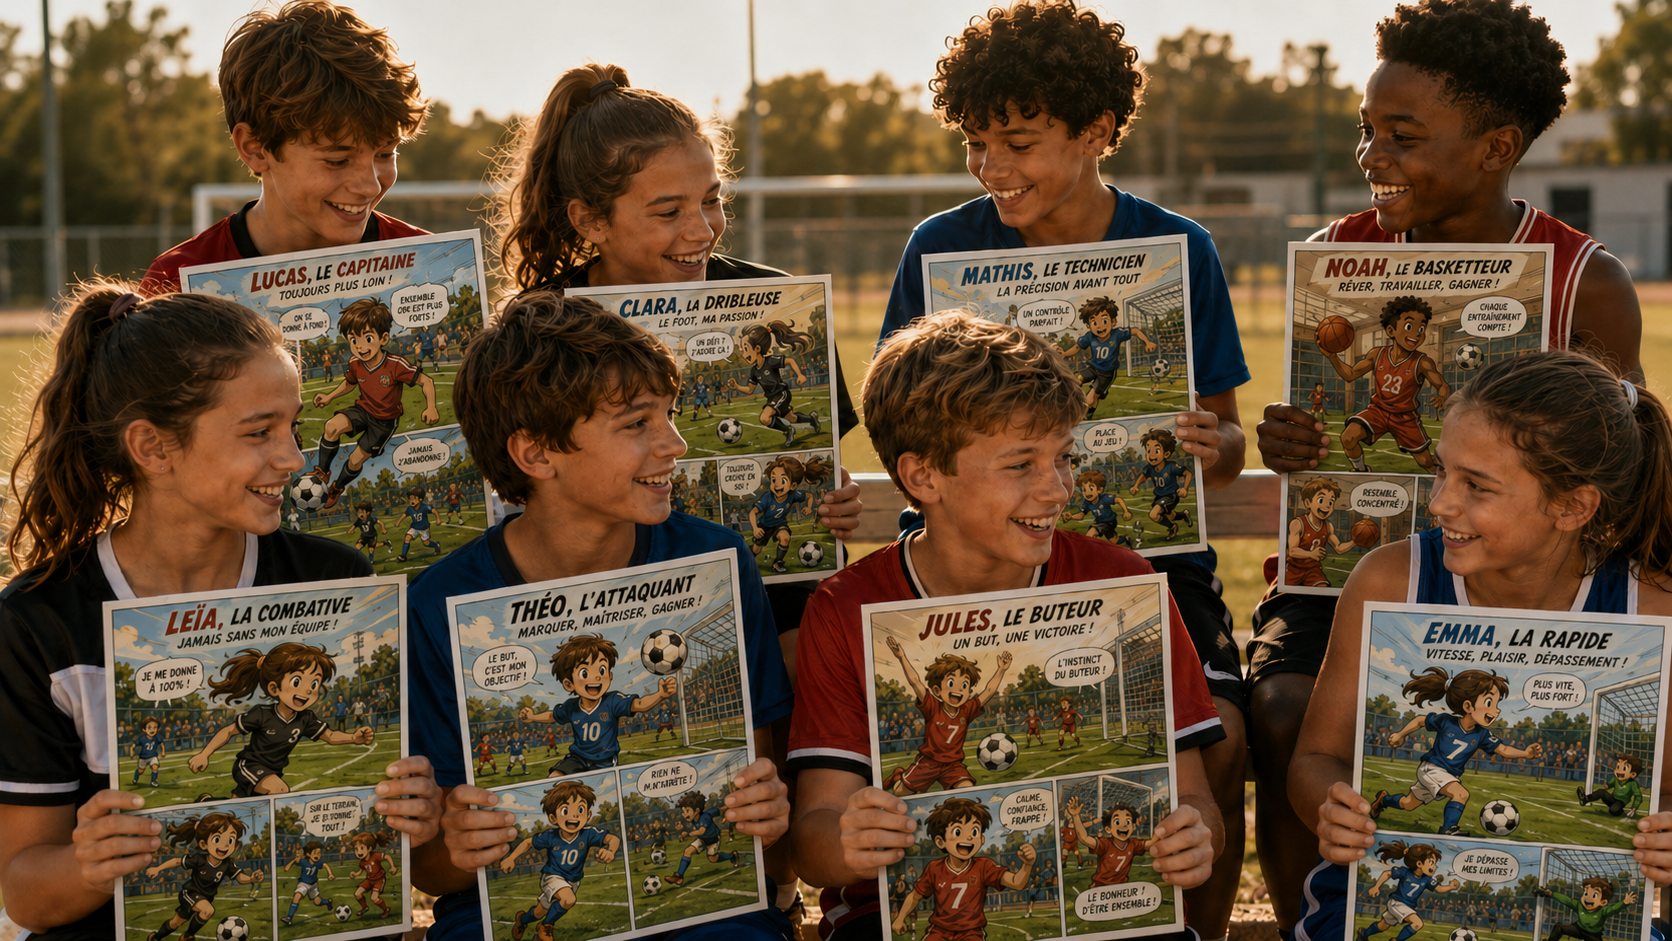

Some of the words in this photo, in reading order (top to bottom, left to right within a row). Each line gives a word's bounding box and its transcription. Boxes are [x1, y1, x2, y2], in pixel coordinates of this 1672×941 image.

[251, 266, 312, 293] LUCAS,
[316, 264, 332, 281] LE
[336, 252, 416, 277] CAPITAINE
[961, 262, 1038, 286] MATHIS,
[1043, 262, 1060, 277] LE
[1064, 253, 1146, 275] TECHNICIEN
[1324, 257, 1391, 279] NOAH,
[1395, 263, 1410, 275] LE
[1413, 259, 1512, 275] BASKETTEUR
[279, 284, 331, 300] TOUJOURS
[334, 280, 358, 292] PLUS
[362, 276, 386, 288] LOIN
[388, 275, 393, 284] !
[997, 287, 1010, 297] LA
[1014, 281, 1070, 295] PRÉCISION
[1073, 276, 1109, 290] AVANT
[1113, 273, 1142, 286] TOUT
[1379, 280, 1445, 292] TRAVAILLER,
[1449, 279, 1493, 290] GAGNER
[1495, 278, 1500, 288] !
[619, 297, 682, 318] CLARA,
[686, 299, 700, 312] LA
[704, 291, 782, 310] DRIBLEUSE
[658, 318, 669, 328] LE
[672, 316, 698, 327] FOOT,
[701, 314, 716, 324] MA
[719, 311, 758, 323] PASSION
[760, 310, 765, 319] !
[1023, 310, 1033, 318] UN
[1095, 346, 1108, 359] 10
[1382, 374, 1403, 394] 23
[1154, 477, 1166, 488] 10
[510, 591, 573, 624] THÉO,
[579, 574, 696, 611] L'ATTAQUANT
[165, 603, 224, 636] LEÏA,
[230, 606, 252, 625] LA
[257, 596, 354, 622] COMBATIVE
[517, 619, 578, 639] MARQUER,
[582, 607, 648, 627] MAÎTRISER,
[652, 597, 695, 615] GAGNER
[697, 595, 703, 606] !
[918, 608, 997, 641] JULES,
[1003, 607, 1026, 627] LE
[1029, 598, 1104, 624] BUTEUR
[177, 633, 222, 649] JAMAIS
[225, 629, 257, 642] SANS
[260, 625, 288, 639] MON
[290, 620, 331, 635] ÉQUIPE
[333, 619, 339, 630] !
[953, 637, 971, 650] UN
[974, 634, 1000, 648] BUT,
[1005, 630, 1030, 643] UNE
[1034, 623, 1086, 640] VICTOIRE
[1089, 622, 1094, 633] !
[1422, 621, 1501, 649] EMMA,
[1508, 628, 1534, 647] LA
[1539, 630, 1613, 650] RAPIDE
[488, 654, 497, 663] LE
[1058, 654, 1102, 668] L'INSTINCT
[1426, 648, 1475, 663] VITESSE,
[1479, 650, 1529, 666] PLAISIR,
[1534, 651, 1621, 668] DÉPASSEMENT
[1621, 657, 1628, 669] !
[142, 671, 151, 681] JE
[155, 669, 167, 680] ME
[170, 665, 197, 678] DONNE
[485, 664, 506, 675] C'EST
[1054, 670, 1066, 680] DU
[1069, 666, 1100, 678] BUTEUR
[160, 680, 184, 692] 100%
[484, 672, 521, 687] OBJECTIF
[1533, 679, 1553, 689] PLUS
[1531, 691, 1551, 700] PLUS
[1552, 692, 1574, 701] FORT
[288, 728, 300, 743] 3
[581, 722, 601, 741] 10
[945, 725, 960, 744] 7
[1446, 739, 1468, 760] 7
[1011, 813, 1041, 825] FRAPPE
[560, 849, 578, 865] 10
[1114, 855, 1127, 872] 7
[1476, 853, 1509, 866] DÉPASSE
[950, 882, 968, 909] 7
[1087, 892, 1097, 902] LE
[1100, 887, 1138, 901] BONHEUR
[1407, 882, 1420, 897] 7
[1111, 897, 1152, 911] ENSEMBLE
